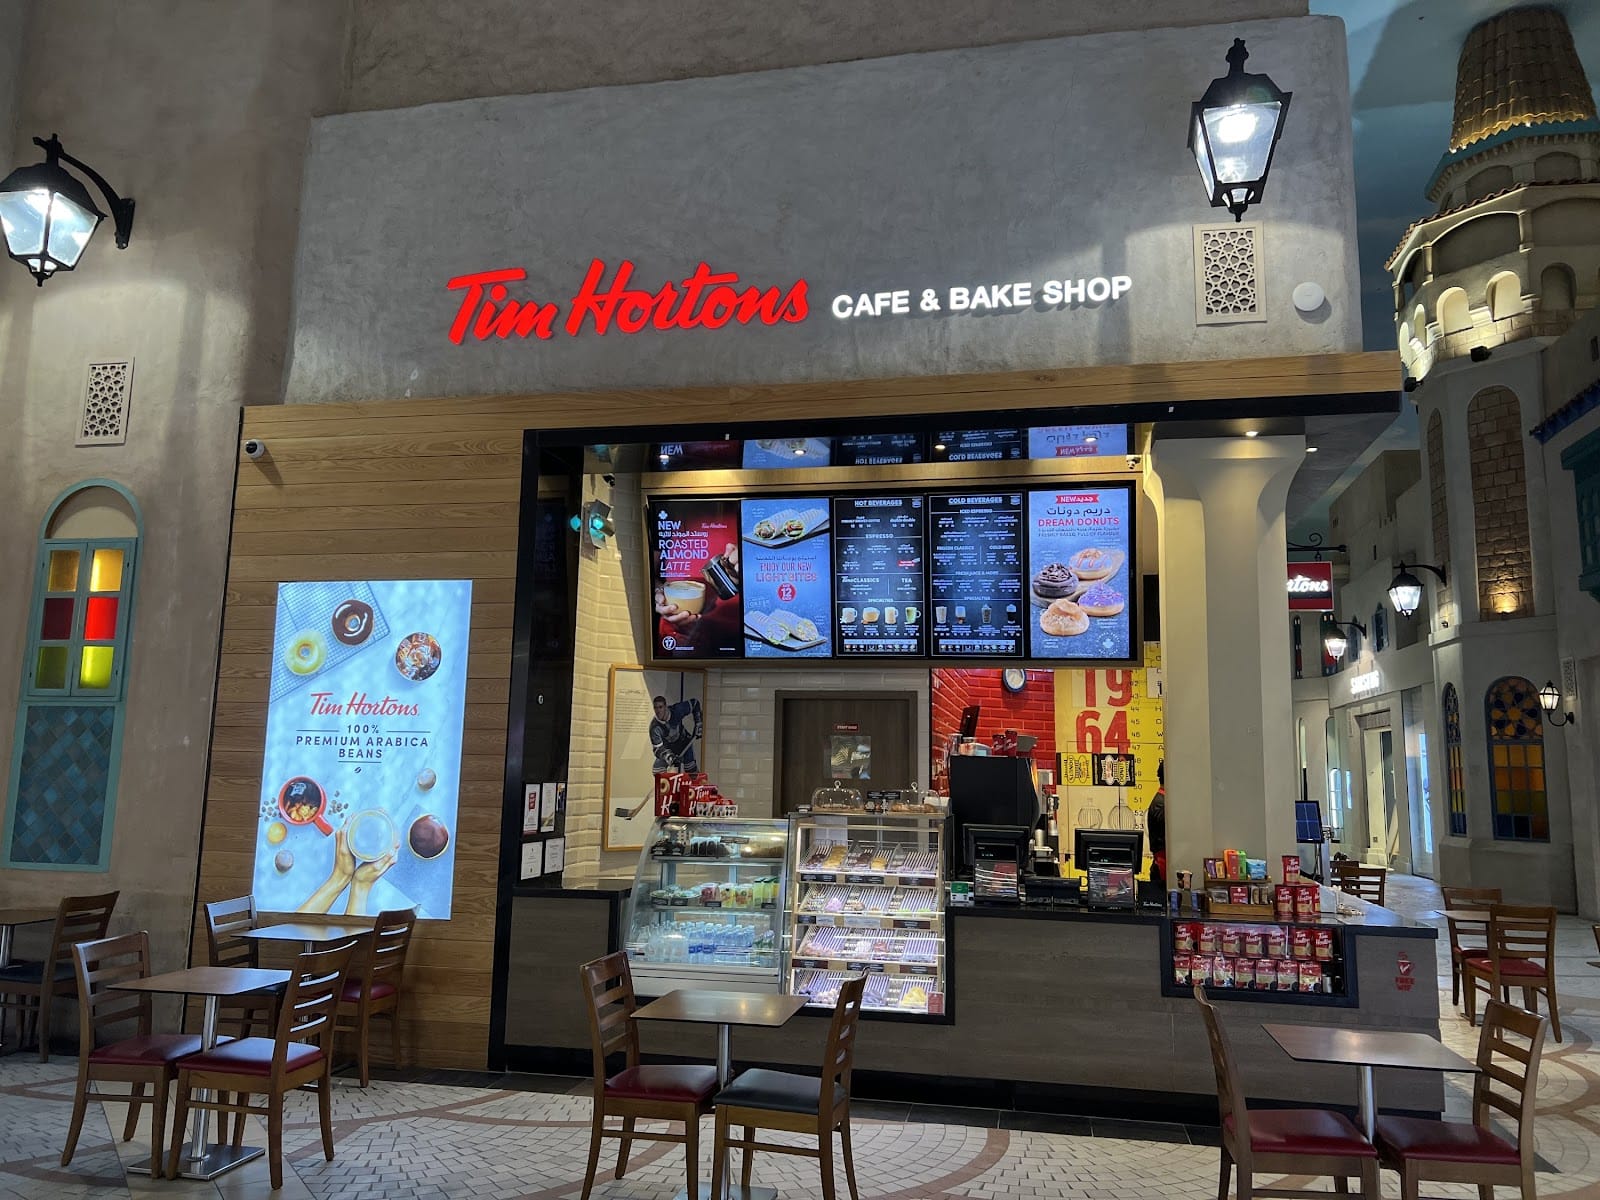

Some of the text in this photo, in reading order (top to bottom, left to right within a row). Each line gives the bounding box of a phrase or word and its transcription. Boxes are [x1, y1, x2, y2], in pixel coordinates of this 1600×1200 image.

[446, 258, 809, 346] Tim Hortons
[832, 275, 1132, 319] CAFE & BAKE SHOP
[1046, 506, 1111, 517] دريم دونات
[658, 521, 681, 530] NEW
[1038, 517, 1120, 527] DREAM DONUTS
[659, 540, 708, 549] ROASTED
[660, 550, 709, 559] ALMOND
[660, 561, 691, 570] LATTE
[782, 562, 795, 571] OUR
[798, 561, 812, 571] NEW
[756, 572, 817, 582] LIGHT BITES
[781, 588, 792, 596] 12
[310, 691, 418, 717] Tim Hortons
[347, 724, 379, 734] 100%
[296, 736, 429, 747] PREMIUM ARABICA
[338, 749, 383, 758] BEANS
